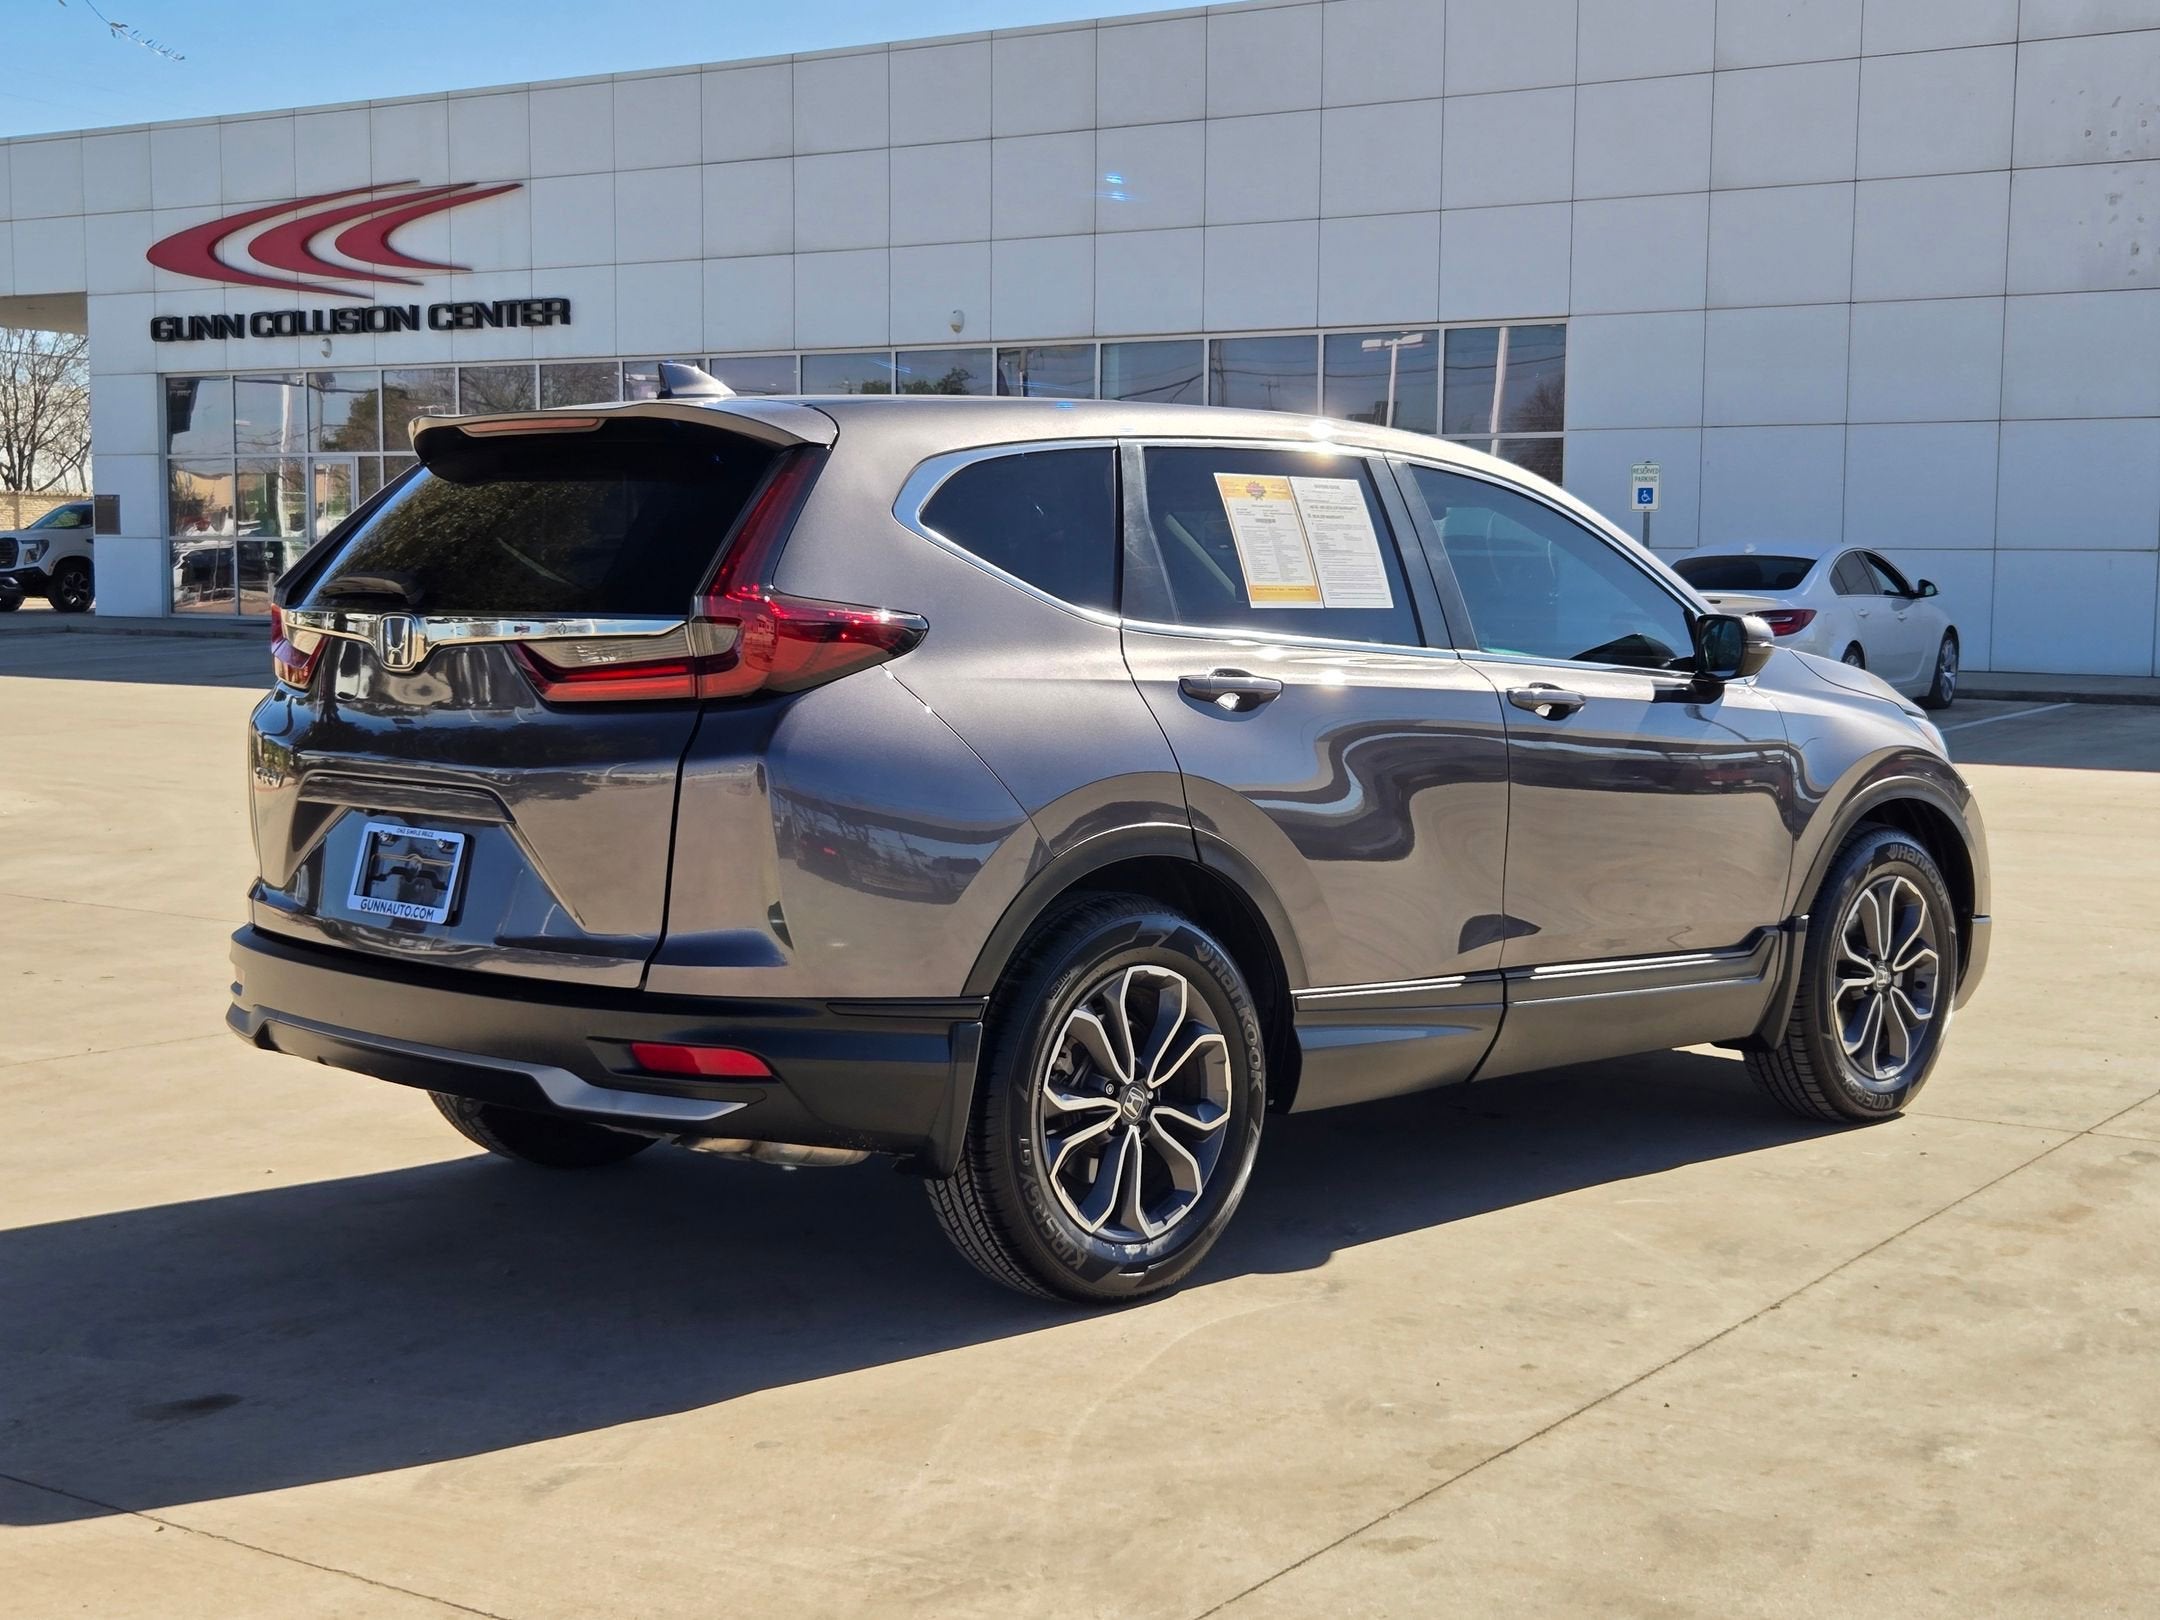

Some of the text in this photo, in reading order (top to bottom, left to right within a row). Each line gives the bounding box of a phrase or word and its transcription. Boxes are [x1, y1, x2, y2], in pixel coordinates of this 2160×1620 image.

[151, 298, 571, 342] GUNN COLLISION CENTER
[360, 898, 435, 920] GUNNAUTO.COM
